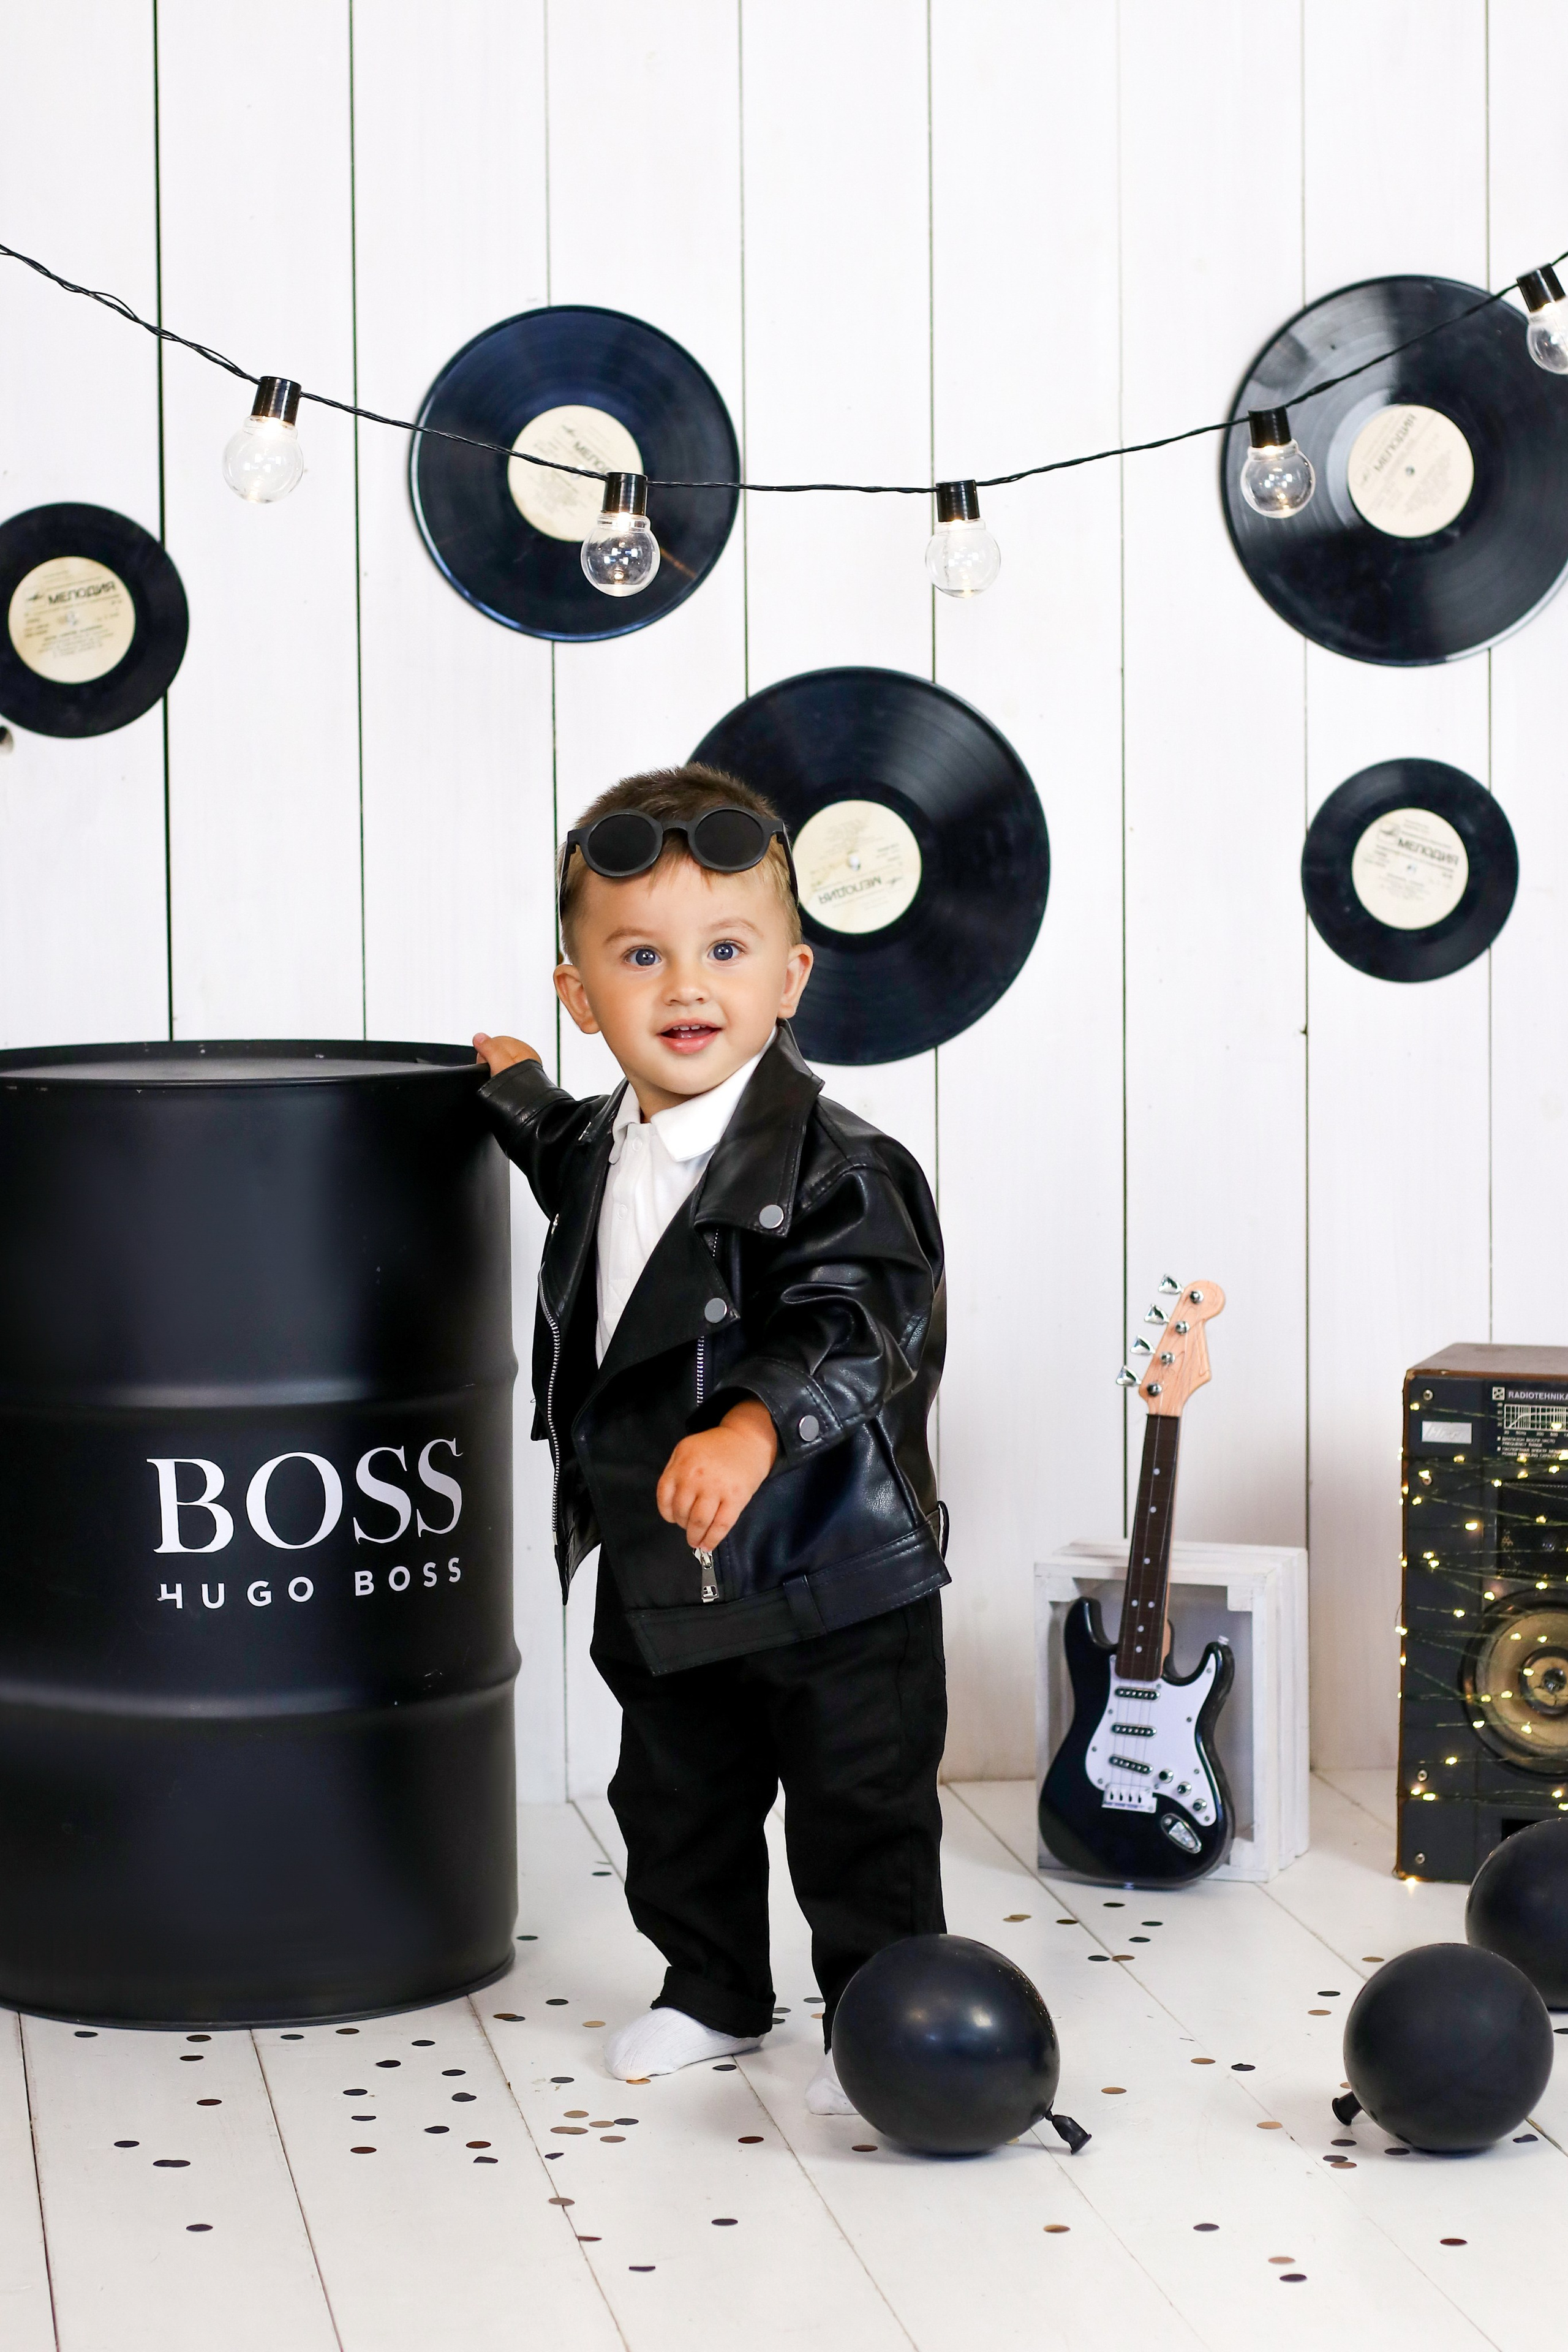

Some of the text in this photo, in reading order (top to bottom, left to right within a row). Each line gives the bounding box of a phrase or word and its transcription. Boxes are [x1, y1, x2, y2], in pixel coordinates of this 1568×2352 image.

[48, 581, 115, 604] МЕЛОДИЯ
[818, 876, 881, 903] МЕЛОДИЯ
[1508, 1391, 1568, 1400] RADIOTEHNIKA
[146, 1438, 463, 1554] BOSS
[157, 1557, 462, 1610] HUGO BOSS
